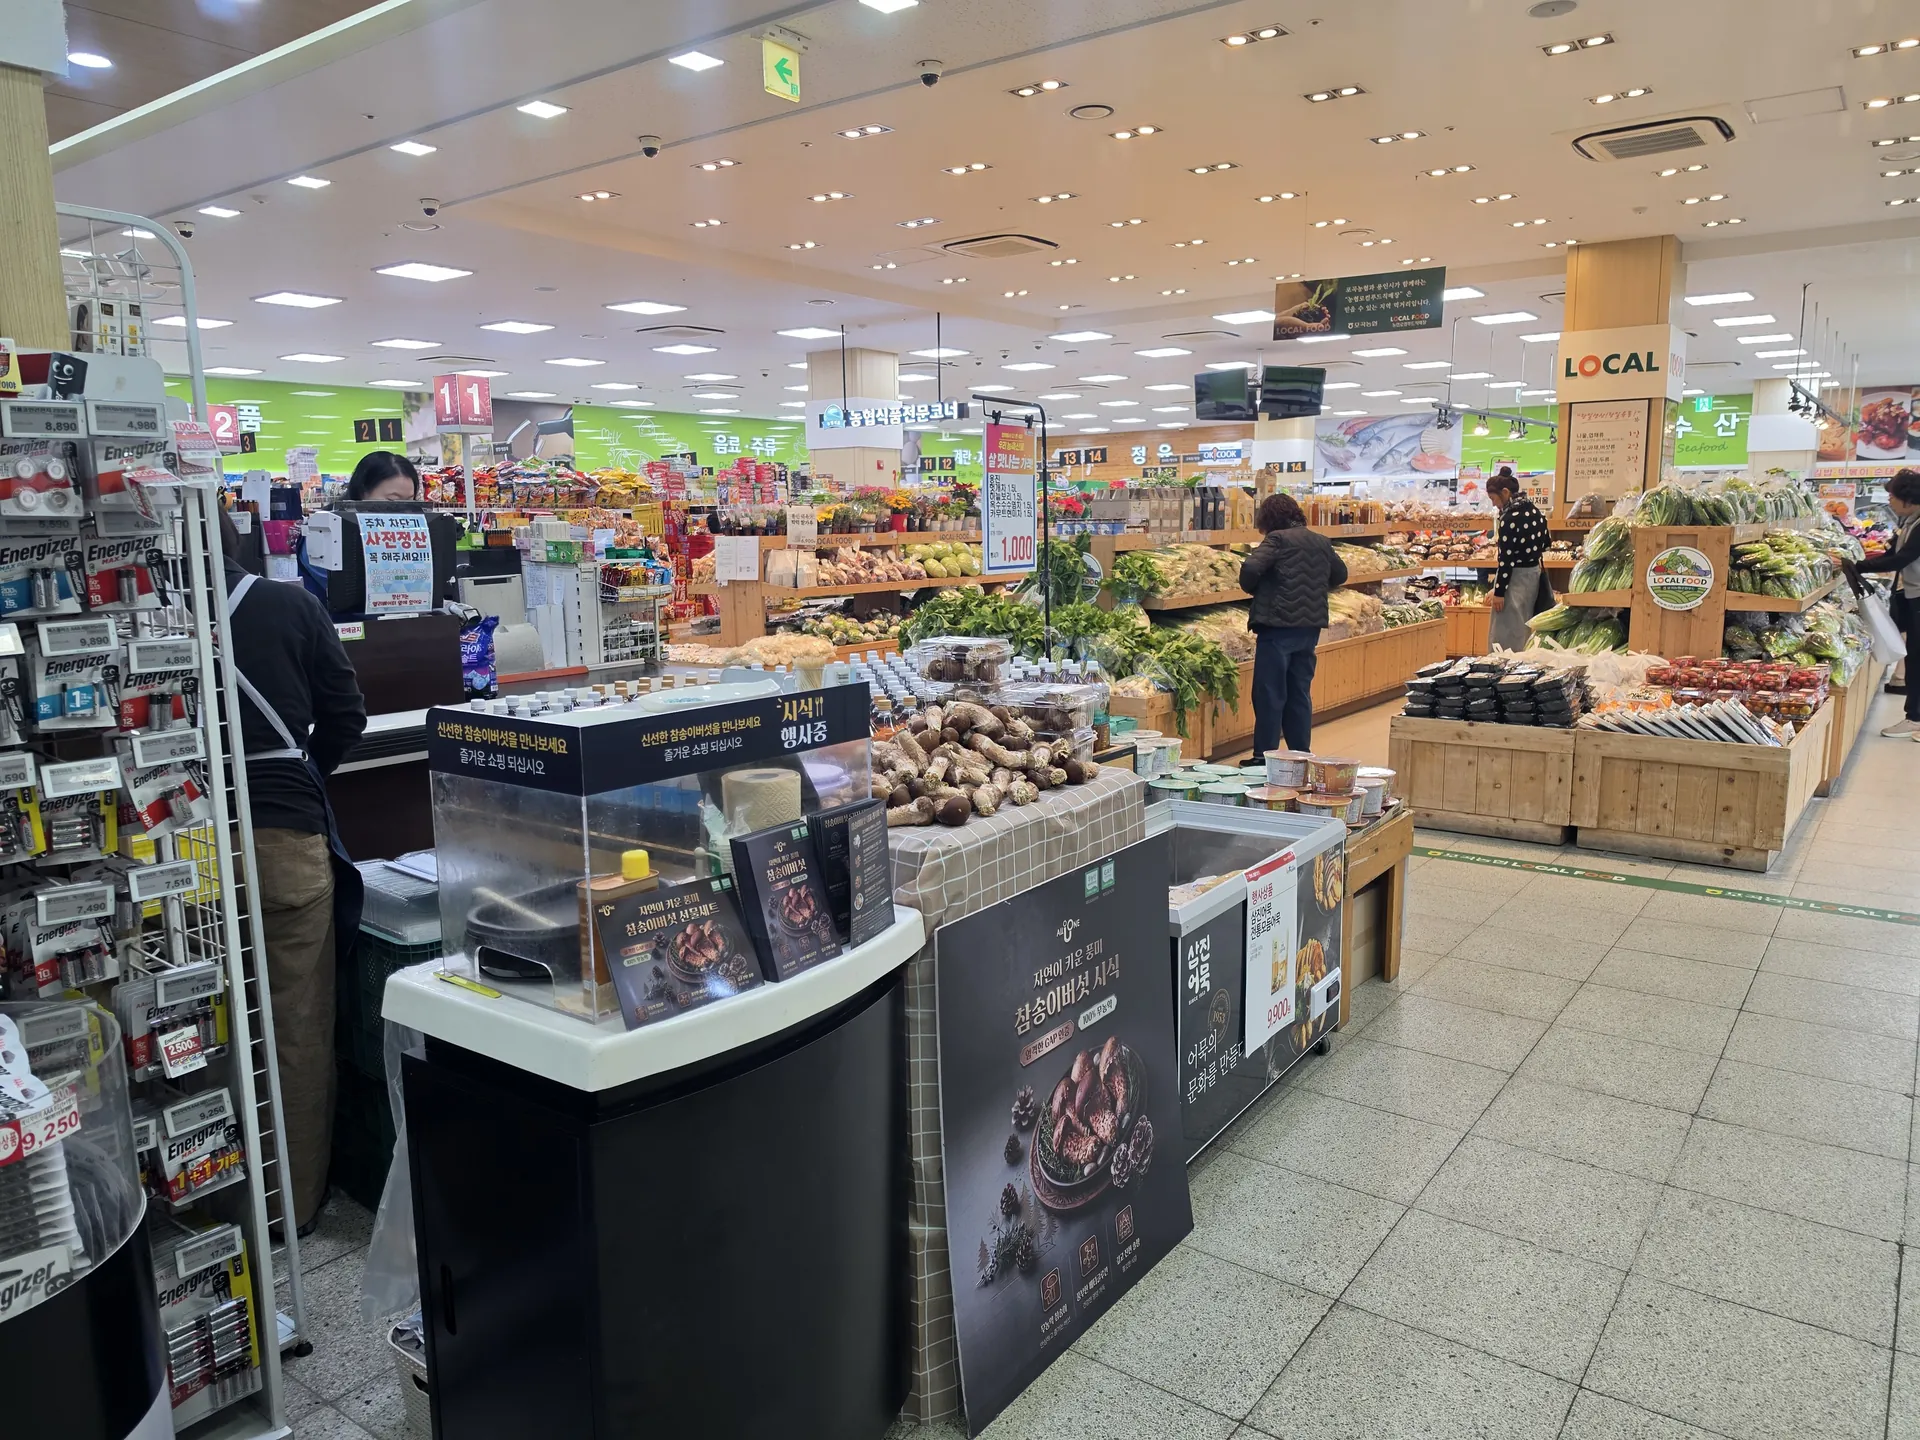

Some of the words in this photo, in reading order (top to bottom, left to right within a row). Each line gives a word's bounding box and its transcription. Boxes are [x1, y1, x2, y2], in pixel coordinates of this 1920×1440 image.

[1390, 314, 1410, 322] LOCAL
[1411, 312, 1430, 321] FOOD
[1276, 326, 1303, 336] LOCAL
[1305, 323, 1331, 333] FOOD
[1564, 351, 1660, 379] LOCAL
[440, 382, 453, 415] 1
[466, 382, 481, 415] 1
[127, 419, 157, 432] 4,980
[214, 411, 235, 438] 2
[849, 400, 959, 428] 농협식품전문코너
[44, 420, 78, 433] 8,890
[361, 421, 370, 441] 2
[387, 420, 395, 440] 1
[0, 439, 50, 457] Energizer
[103, 439, 170, 463] Energizer
[244, 434, 253, 452] 3
[1676, 441, 1729, 455] Seafood
[923, 458, 934, 471] 11
[942, 458, 954, 472] 12
[1063, 452, 1077, 466] 13
[1089, 450, 1102, 464] 14
[1290, 461, 1303, 473] 14
[364, 516, 386, 531] 주차
[389, 516, 421, 531] 차단기
[1422, 521, 1447, 530] LOCAL
[1448, 520, 1471, 530] FOOD
[1564, 519, 1593, 529] LOCAL
[0, 536, 79, 566] Energizer
[87, 535, 159, 562] Energizer
[364, 530, 430, 551] 사전정산
[836, 536, 853, 545] FOOD
[1001, 535, 1033, 563] 1,000
[101, 556, 122, 566] MAX
[369, 551, 379, 564] 꼭
[381, 551, 431, 564] 해주세요!!!
[1653, 577, 1681, 585] LOCAL
[1681, 577, 1708, 586] FOOD
[80, 636, 110, 649] 9,890
[45, 652, 111, 677] Energizer
[165, 655, 192, 667] 4,890
[123, 667, 194, 691] Energizer
[136, 682, 157, 693] MAX
[781, 695, 814, 724] 시식
[437, 720, 464, 742] 신선한
[463, 724, 519, 750] 참송이버섯을
[518, 734, 569, 757] 만나보세요
[640, 731, 669, 749] 신선한
[669, 720, 721, 745] 참송이버섯을
[721, 715, 763, 735] 만나보세요
[779, 719, 829, 751] 행사중
[170, 744, 197, 758] 6,590
[459, 747, 488, 770] 즐거운
[487, 752, 507, 772] 쇼핑
[506, 755, 547, 777] 되십시오
[663, 745, 692, 764] 즐거운
[691, 740, 709, 758] 쇼핑
[710, 736, 744, 755] 되십시오
[39, 790, 97, 815] Energizer
[766, 858, 808, 884] 참송이버섯
[1510, 860, 1570, 875] LOCAL
[1572, 869, 1627, 883] FOOD
[164, 878, 192, 892] 7,510
[1251, 881, 1274, 907] 행사상품
[77, 901, 106, 915] 7,490
[638, 900, 666, 917] 자연이
[665, 896, 684, 912] 키운
[683, 891, 701, 908] 풍미
[624, 914, 680, 938] 참송이버섯
[679, 901, 722, 925] 선물세트
[36, 918, 83, 947] Energizer
[1033, 958, 1064, 990] 자연이
[1064, 947, 1085, 973] 키운
[1085, 937, 1105, 962] 풍미
[1187, 933, 1211, 974] 삼진
[190, 982, 216, 996] 11,790
[1187, 961, 1211, 995] 어묵
[1014, 970, 1092, 1038] 참송이버섯
[1091, 953, 1121, 993] 시식
[1024, 1040, 1045, 1062] 엄격한
[1044, 1033, 1058, 1051] GAP
[1186, 1027, 1219, 1070] 어묵의
[1186, 1060, 1219, 1106] 문화를
[199, 1106, 226, 1121] 9,250
[21, 1109, 81, 1153] 9,250
[168, 1116, 230, 1164] Energizer
[181, 1145, 198, 1160] MAX
[209, 1242, 237, 1261] 17,790
[158, 1259, 222, 1310] Energizer
[171, 1293, 190, 1309] MAX
